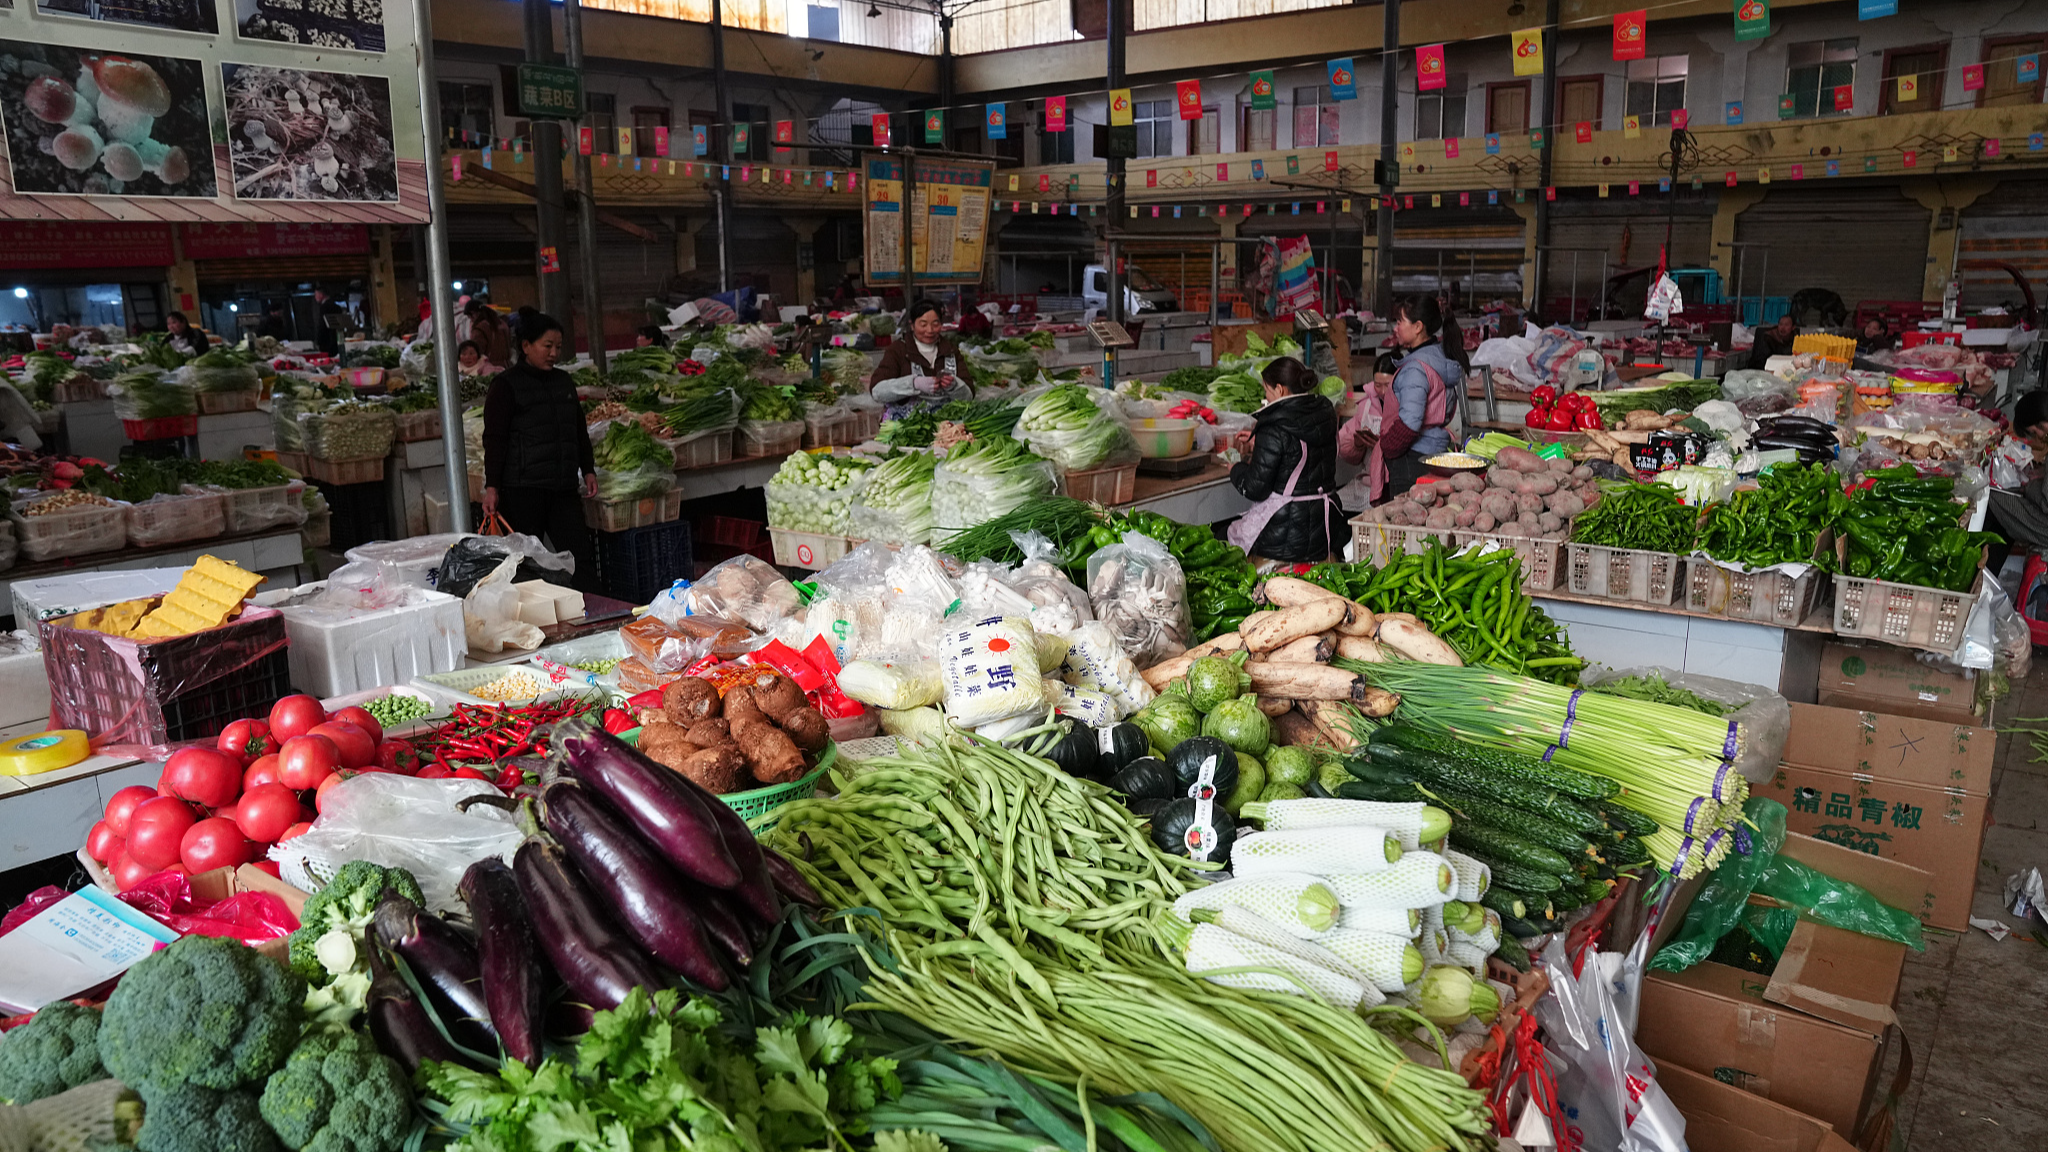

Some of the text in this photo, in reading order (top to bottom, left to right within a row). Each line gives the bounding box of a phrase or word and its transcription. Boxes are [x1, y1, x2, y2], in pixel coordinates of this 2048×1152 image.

[524, 84, 576, 109] 蔬菜B区
[937, 194, 948, 206] 30
[1793, 785, 1923, 831] 精品青椒
